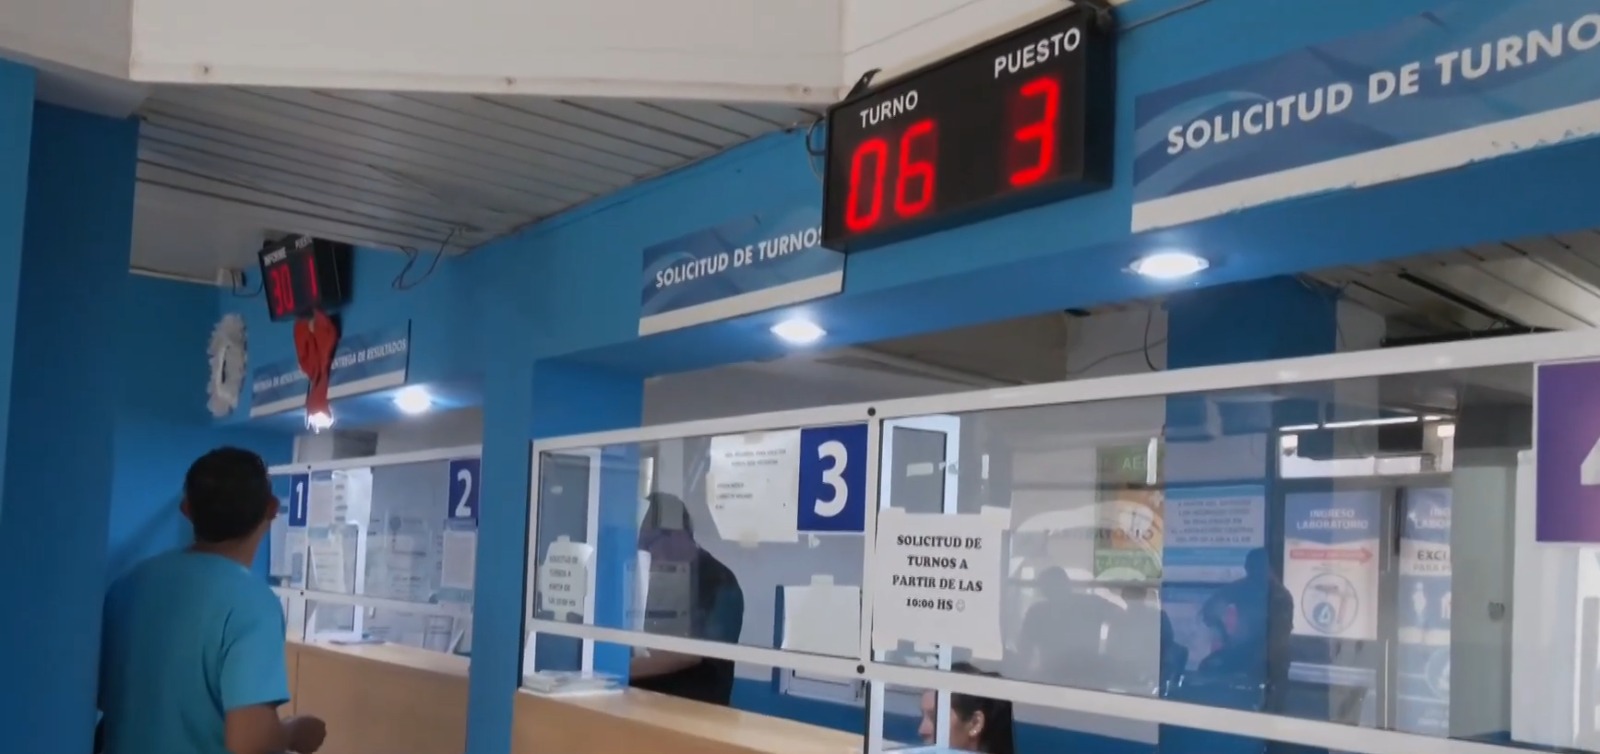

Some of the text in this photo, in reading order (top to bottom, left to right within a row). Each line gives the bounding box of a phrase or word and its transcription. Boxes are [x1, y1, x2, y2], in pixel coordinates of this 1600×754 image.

[994, 27, 1081, 78] PUESTO
[859, 90, 918, 128] TURNO
[1167, 82, 1353, 155] SOLICITUD
[1368, 62, 1421, 104] DE
[1009, 76, 1061, 187] 3
[845, 118, 936, 232] 06
[309, 255, 317, 297] 1
[656, 253, 729, 288] SOLICITUD
[734, 245, 753, 268] DE
[271, 264, 294, 316] 30
[455, 469, 472, 517] 2
[814, 440, 848, 517] 3
[296, 482, 303, 519] 1
[1310, 508, 1355, 518] INGRESO
[897, 534, 983, 549] SOLICITUD DE
[1297, 520, 1369, 530] LABORATORIO
[892, 574, 983, 592] PARTIR DE LAS
[907, 555, 968, 570] TURNOS A
[906, 598, 954, 611] 10:00 HS
